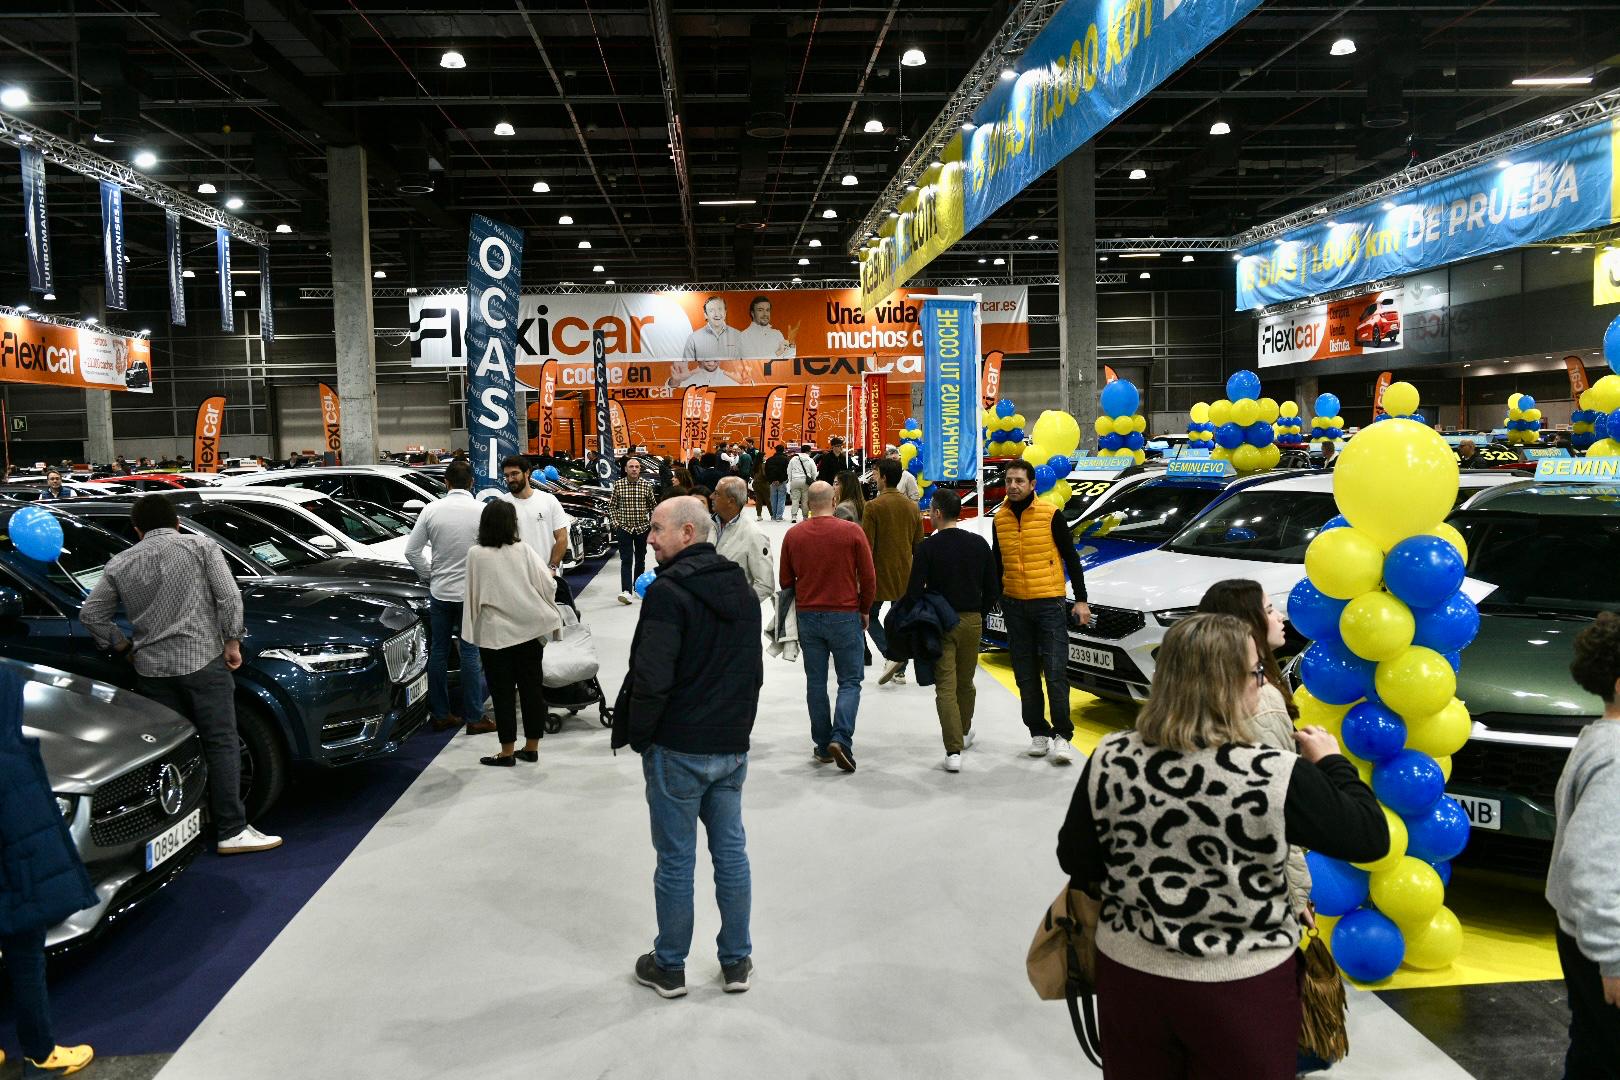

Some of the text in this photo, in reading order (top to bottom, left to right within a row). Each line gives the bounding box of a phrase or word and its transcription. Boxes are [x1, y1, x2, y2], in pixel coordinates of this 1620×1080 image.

[1404, 204, 1441, 248] DE
[1447, 158, 1580, 237] PRUEBA
[826, 301, 866, 325] Una
[827, 325, 908, 349] muchos
[1262, 319, 1320, 355] Flexicar
[0, 331, 78, 376] Flexicar
[627, 366, 651, 382] en
[804, 383, 822, 444] Flexicar
[872, 420, 882, 457] COCHES
[1079, 458, 1131, 468] SEMINUEVO
[1168, 461, 1224, 473] SEMINUEVO
[1070, 647, 1111, 666] 2339 MJC
[154, 814, 198, 863] 0894 LSS
